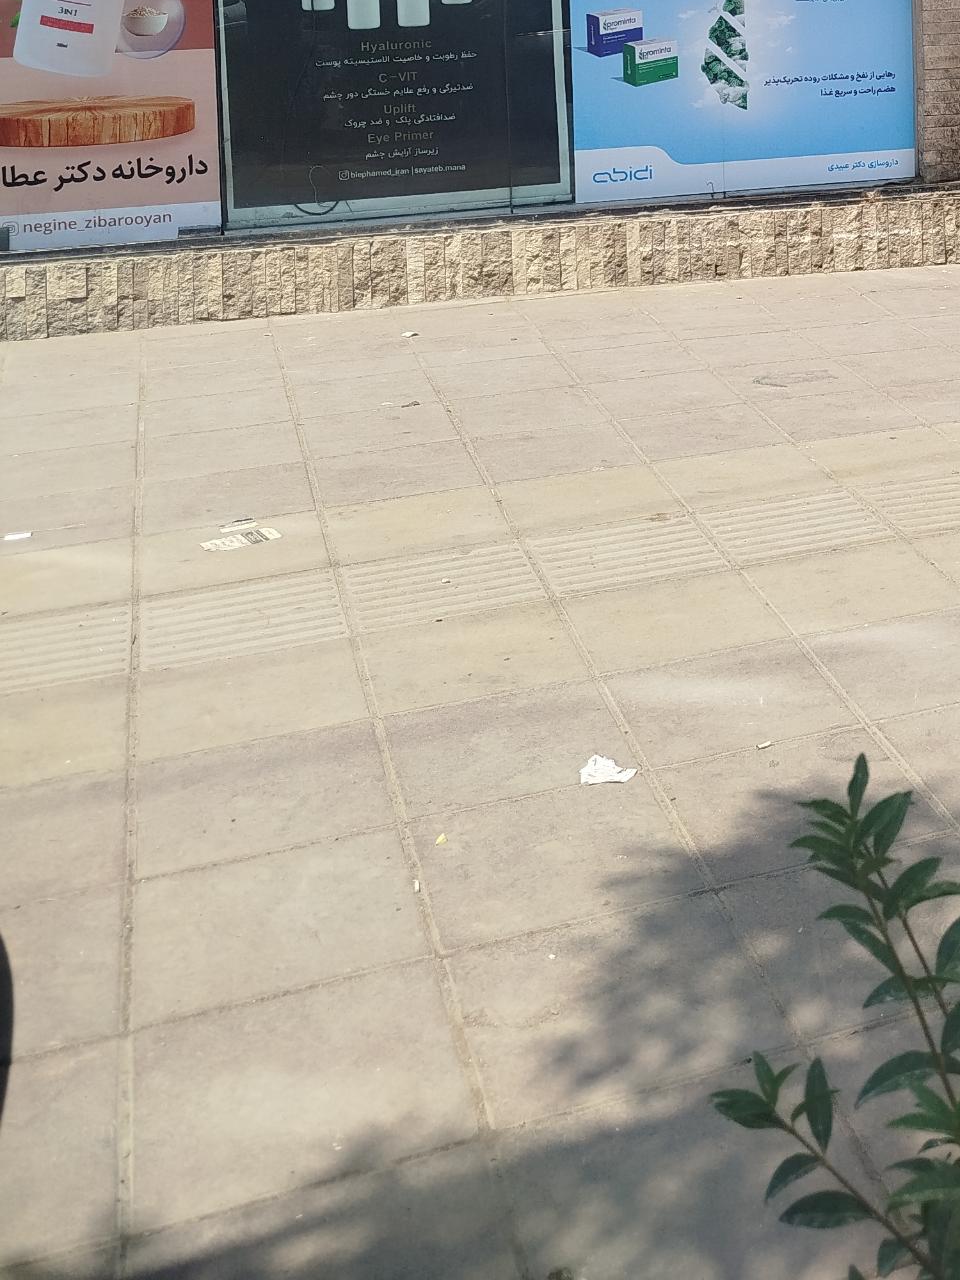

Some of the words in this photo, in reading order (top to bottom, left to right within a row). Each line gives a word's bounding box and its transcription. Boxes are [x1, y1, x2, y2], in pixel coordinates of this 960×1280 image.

[606, 17, 637, 30] prominta
[361, 39, 433, 54] Hyaluronic
[392, 53, 423, 62] خاصیت
[432, 52, 458, 61] رطوبت
[461, 50, 478, 59] حفظ
[642, 46, 672, 59] prominta
[315, 59, 341, 69] پوست
[803, 76, 821, 84] روده
[821, 73, 850, 81] مشکلات
[856, 71, 869, 82] نفخ
[869, 71, 875, 80] از
[875, 70, 896, 81] رهایی
[345, 91, 359, 100] دور
[361, 88, 391, 99] خستگی
[416, 86, 430, 96] رفع
[820, 88, 834, 97] غذا
[834, 89, 853, 97] سریع
[858, 86, 876, 95] راحت
[876, 85, 896, 96] هضم
[323, 92, 343, 101] چشم
[383, 103, 417, 115] Uplift
[344, 120, 367, 128] چروک
[370, 118, 382, 126] ضد
[395, 116, 411, 125] پلک
[367, 133, 390, 145] Eye
[394, 131, 434, 142] Primer
[365, 151, 386, 161] چشم
[388, 147, 411, 159] آرایش
[112, 154, 209, 185] داروخانه
[827, 161, 850, 173] عبیدی
[850, 160, 866, 171] دکتر
[867, 158, 899, 170] داروسازی
[1, 165, 48, 188] عطا
[53, 160, 106, 192] دکتر
[593, 164, 654, 183] abidi
[23, 211, 172, 236] negine_zibarooyan
